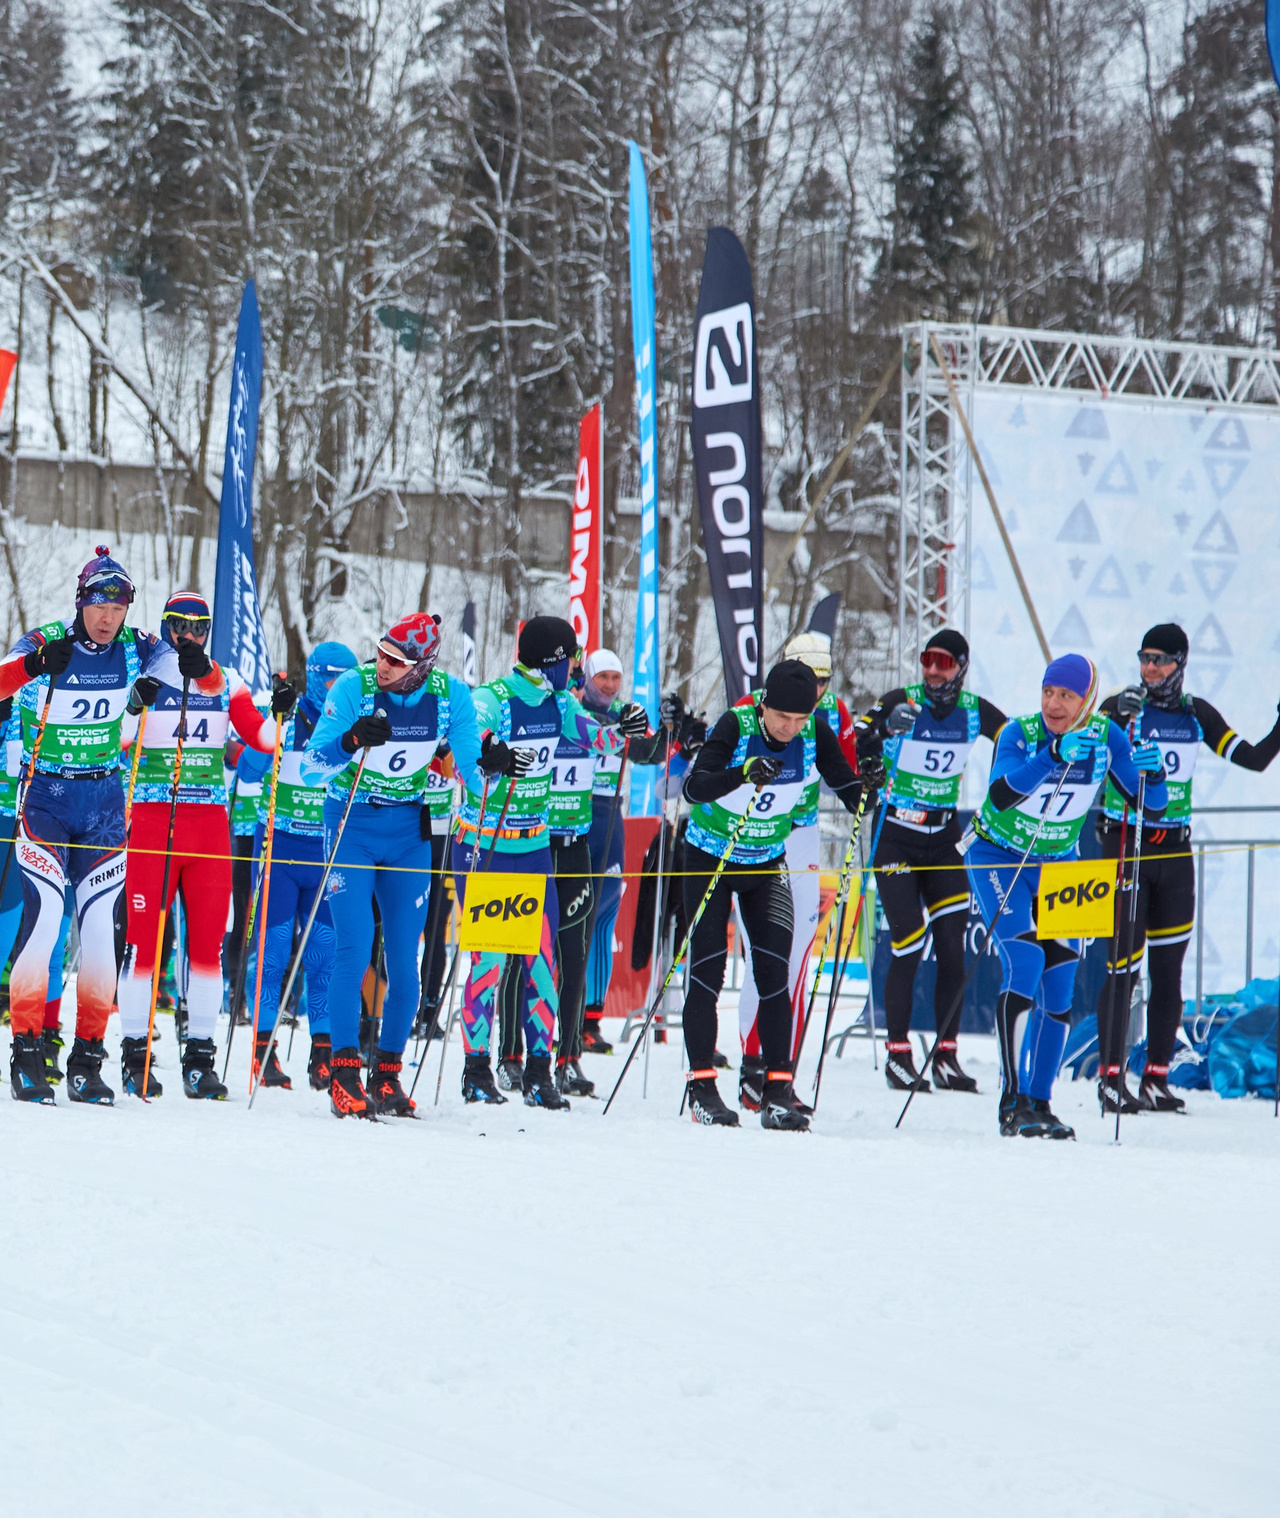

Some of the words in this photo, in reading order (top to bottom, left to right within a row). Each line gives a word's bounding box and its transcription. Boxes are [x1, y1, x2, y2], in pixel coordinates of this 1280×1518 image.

[80, 677, 119, 685] TOKSOVOCUP
[431, 675, 445, 689] 51
[72, 698, 111, 719] 20
[172, 718, 209, 742] 44
[741, 715, 755, 728] 51
[57, 735, 110, 746] TYRES
[388, 750, 407, 772] 6
[924, 749, 955, 773] 52
[552, 766, 578, 786] 14
[756, 792, 776, 812] 8
[1040, 792, 1075, 817] 17
[21, 853, 51, 875] TEAM
[1045, 878, 1110, 912] TOKO
[470, 893, 538, 923] TOKO
